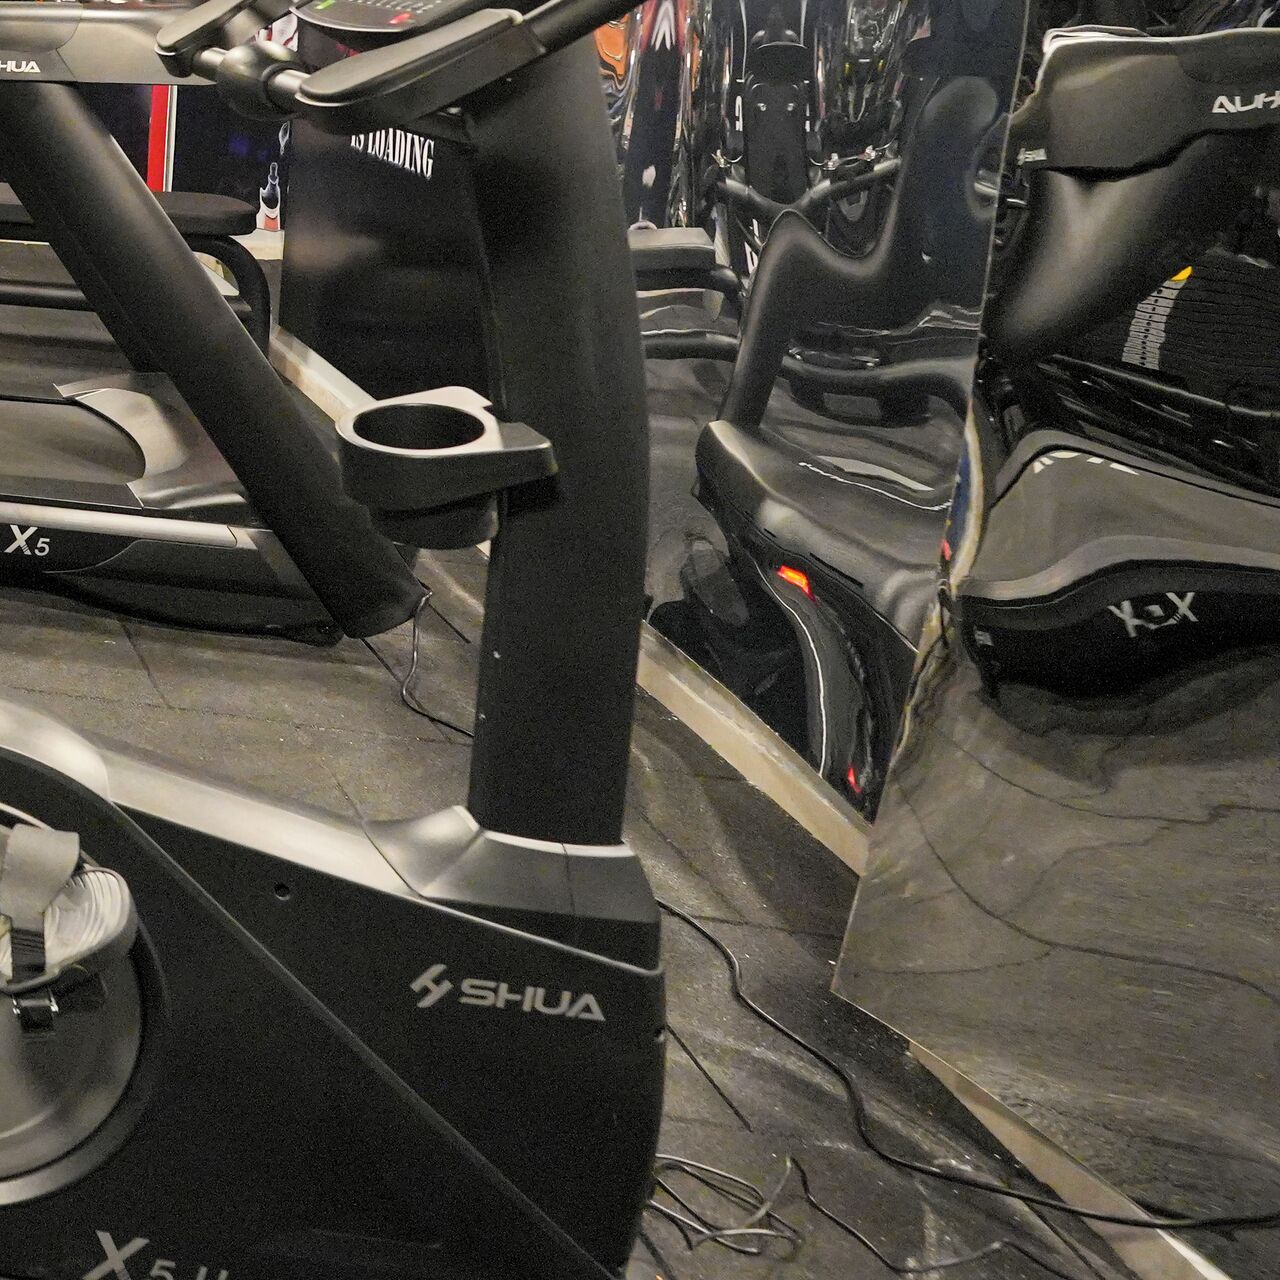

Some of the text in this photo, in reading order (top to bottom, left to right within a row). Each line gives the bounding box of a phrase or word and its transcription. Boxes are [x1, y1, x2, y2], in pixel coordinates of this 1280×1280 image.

[367, 127, 435, 179] LOADING
[3, 524, 50, 557] X5
[458, 978, 606, 1021] SHUA
